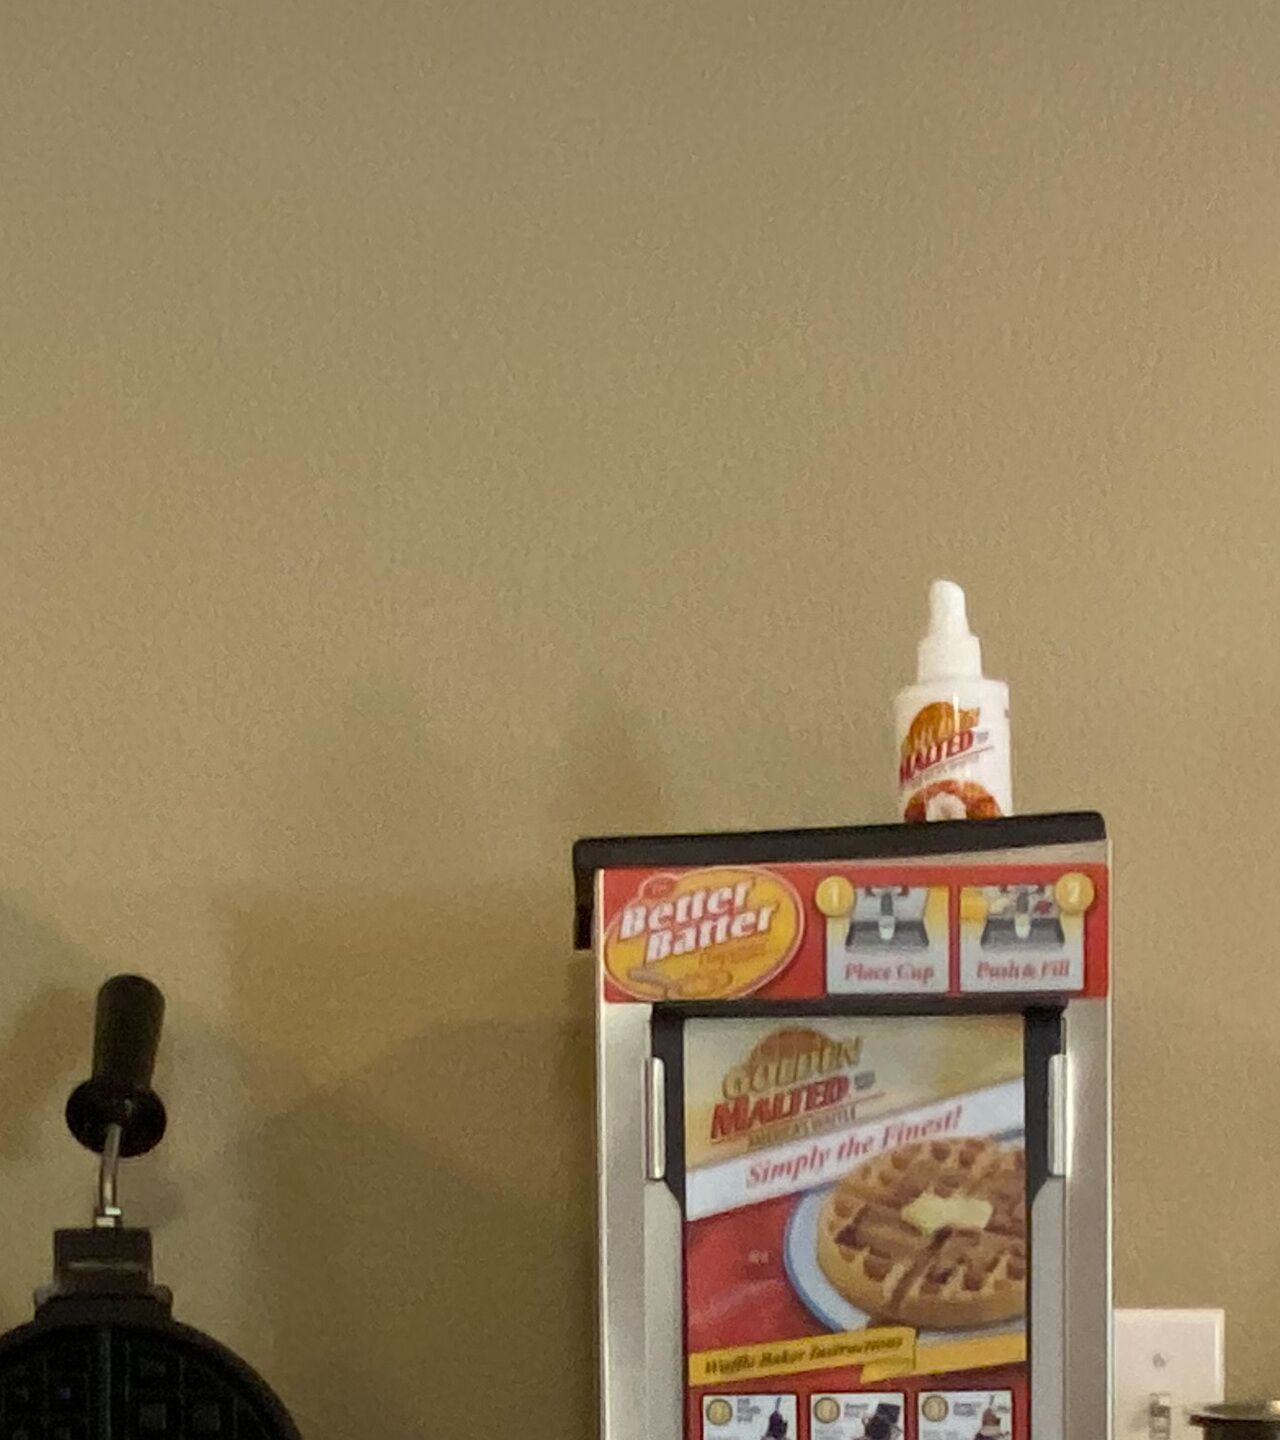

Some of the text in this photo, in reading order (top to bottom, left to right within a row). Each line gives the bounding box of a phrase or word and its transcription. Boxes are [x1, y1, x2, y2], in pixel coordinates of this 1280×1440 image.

[619, 876, 754, 941] Better
[644, 902, 779, 964] Batter
[845, 960, 934, 983] Place Cup
[976, 960, 1019, 980] Push
[1038, 959, 1071, 980] Fill
[710, 1075, 850, 1140] MALTED
[747, 1104, 962, 1188] Simply the Finest!
